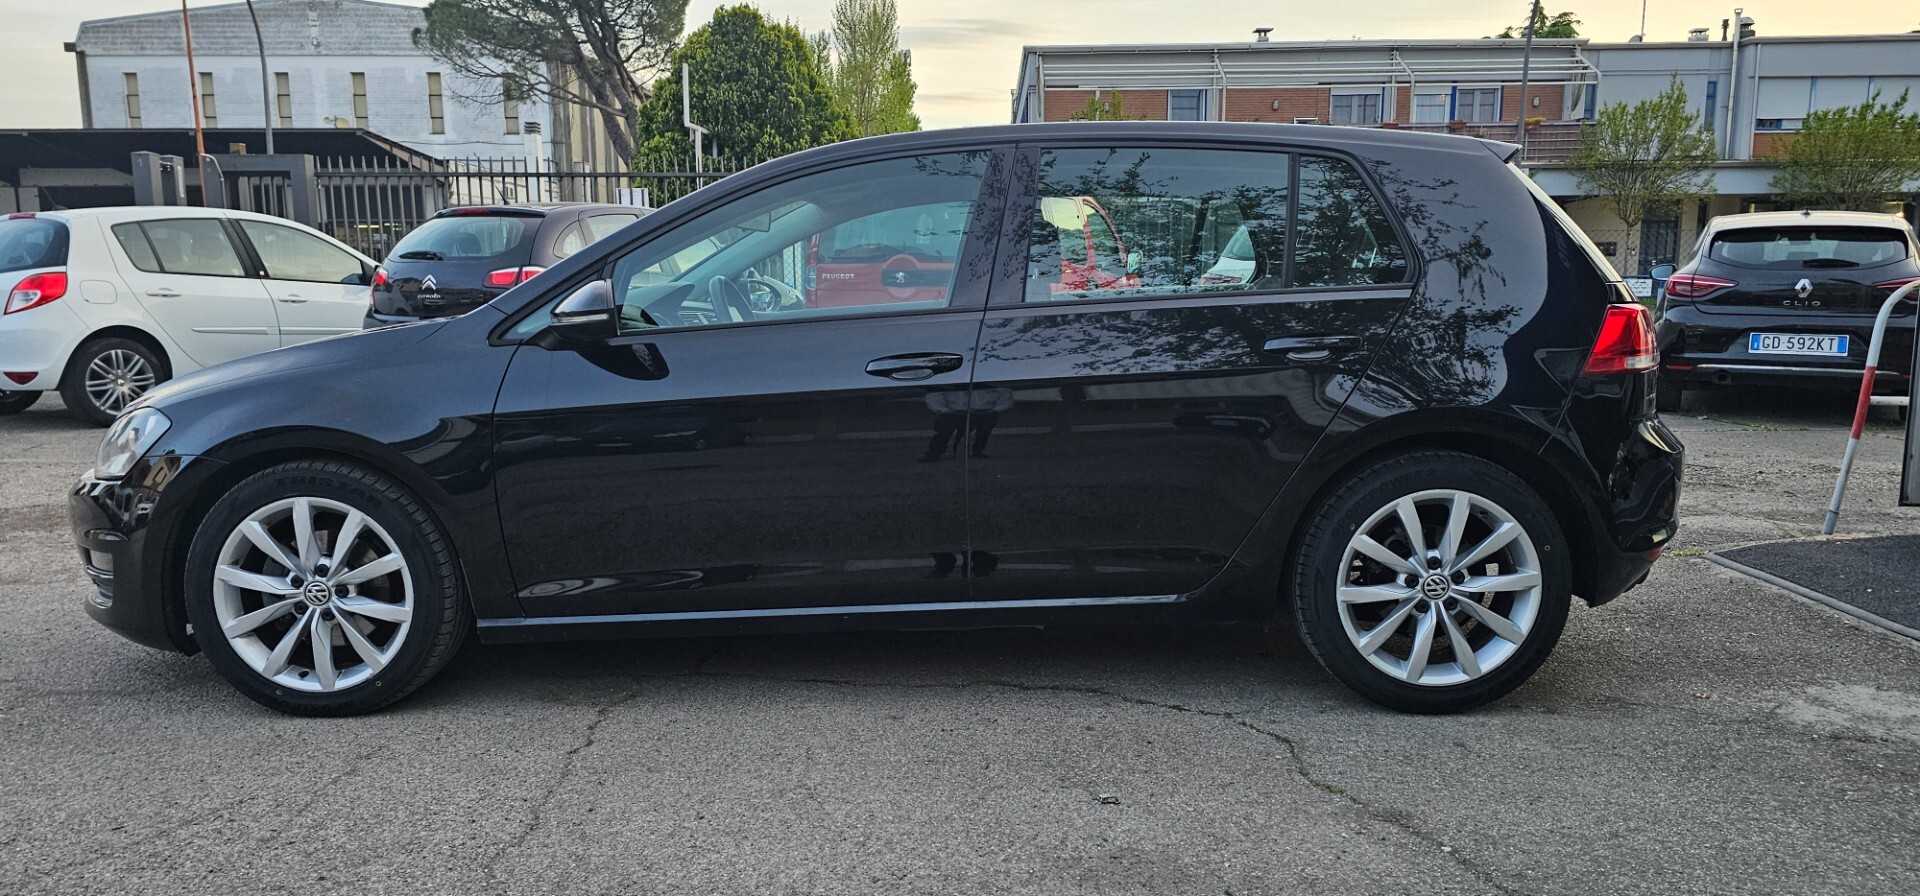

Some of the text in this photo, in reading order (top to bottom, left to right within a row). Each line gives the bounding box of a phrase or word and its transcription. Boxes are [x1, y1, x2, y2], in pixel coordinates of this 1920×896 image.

[1762, 336, 1836, 351] GD 592KT
[273, 475, 383, 508] TRISTAR
